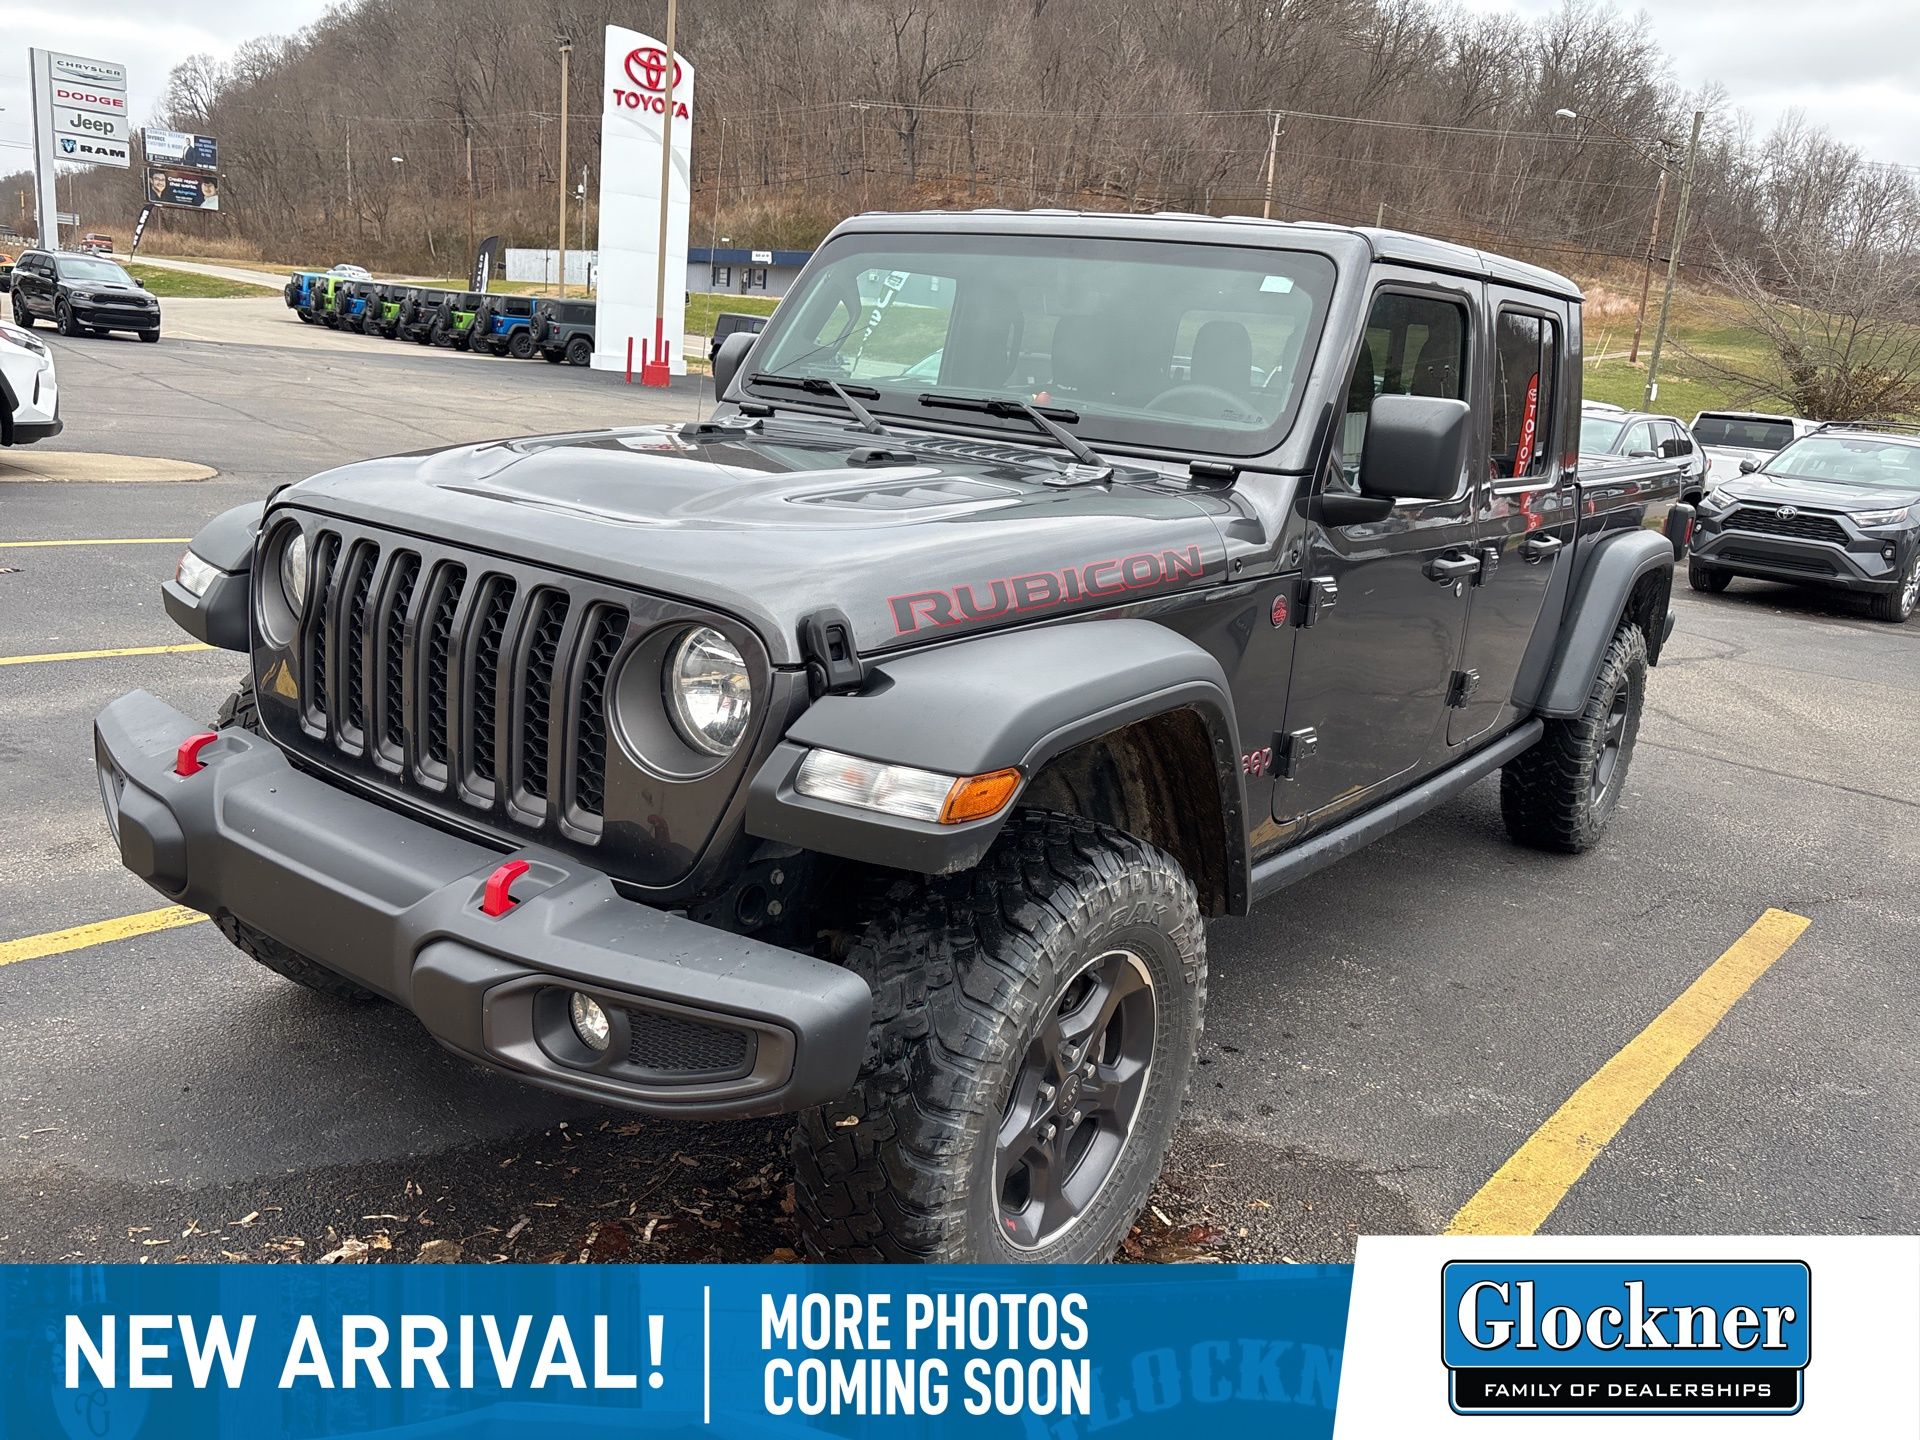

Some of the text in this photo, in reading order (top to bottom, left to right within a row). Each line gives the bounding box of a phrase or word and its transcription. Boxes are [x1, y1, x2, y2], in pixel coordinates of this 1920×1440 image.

[57, 60, 121, 76] CHRYSLER
[57, 89, 124, 107] DODGE
[70, 113, 115, 135] Jeep
[80, 144, 125, 158] RAM
[888, 544, 1204, 635] RUBICON
[1241, 747, 1273, 778] eep
